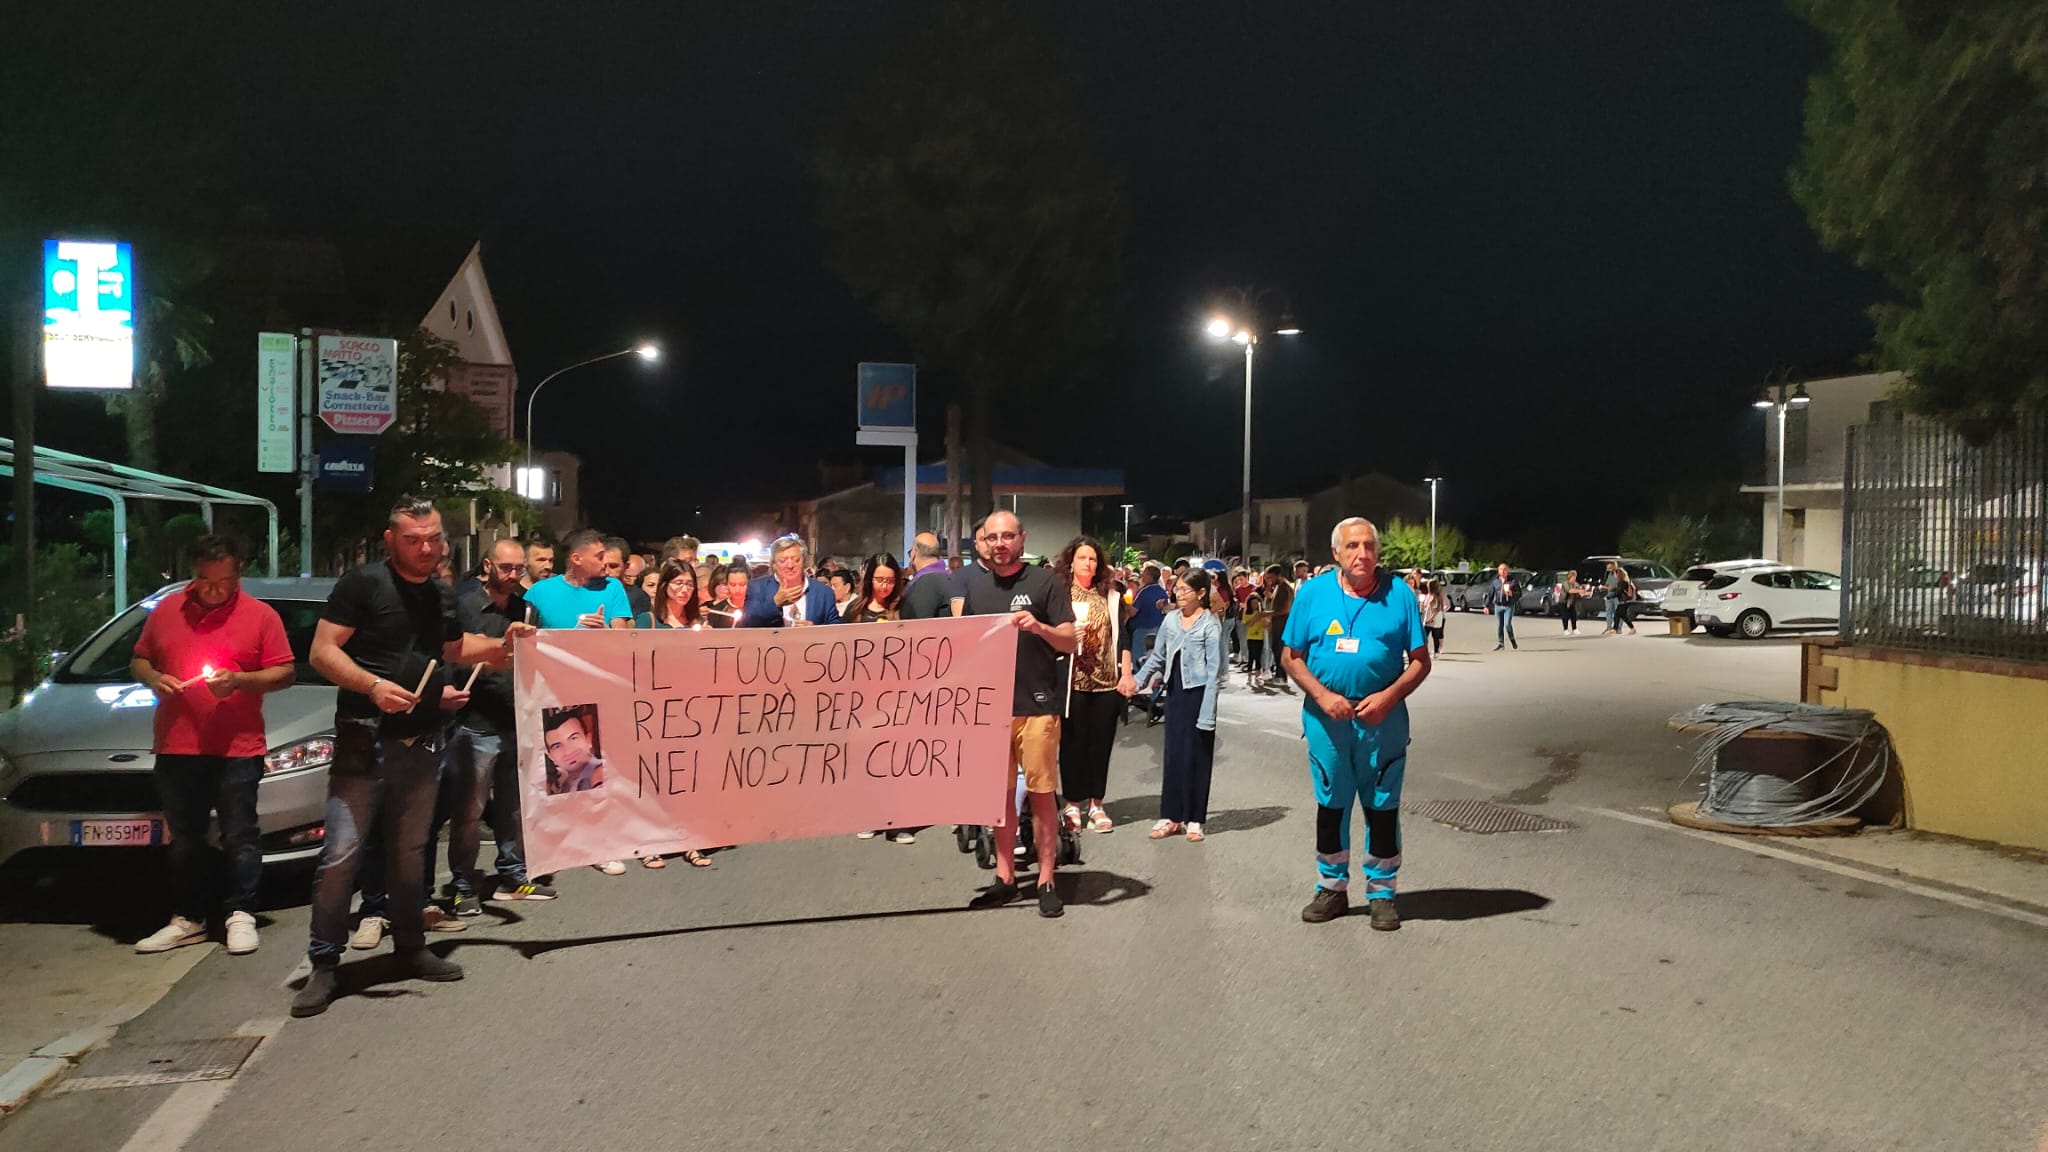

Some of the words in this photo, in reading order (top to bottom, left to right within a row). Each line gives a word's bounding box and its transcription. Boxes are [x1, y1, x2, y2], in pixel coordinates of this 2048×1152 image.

[323, 349, 361, 360] MATTO
[325, 390, 387, 402] Snack-Bar
[323, 400, 390, 411] Cornetteria
[333, 413, 379, 426] Pizzeria
[631, 648, 673, 693] IL
[700, 646, 786, 685] TUO
[803, 636, 953, 684] SORRISO
[635, 684, 796, 741] RESTERÀ
[816, 692, 863, 732] PER
[871, 686, 997, 729] SEMPRE
[637, 750, 699, 799] NEI
[722, 743, 848, 791] NOSTRI
[867, 739, 962, 779] CUORI
